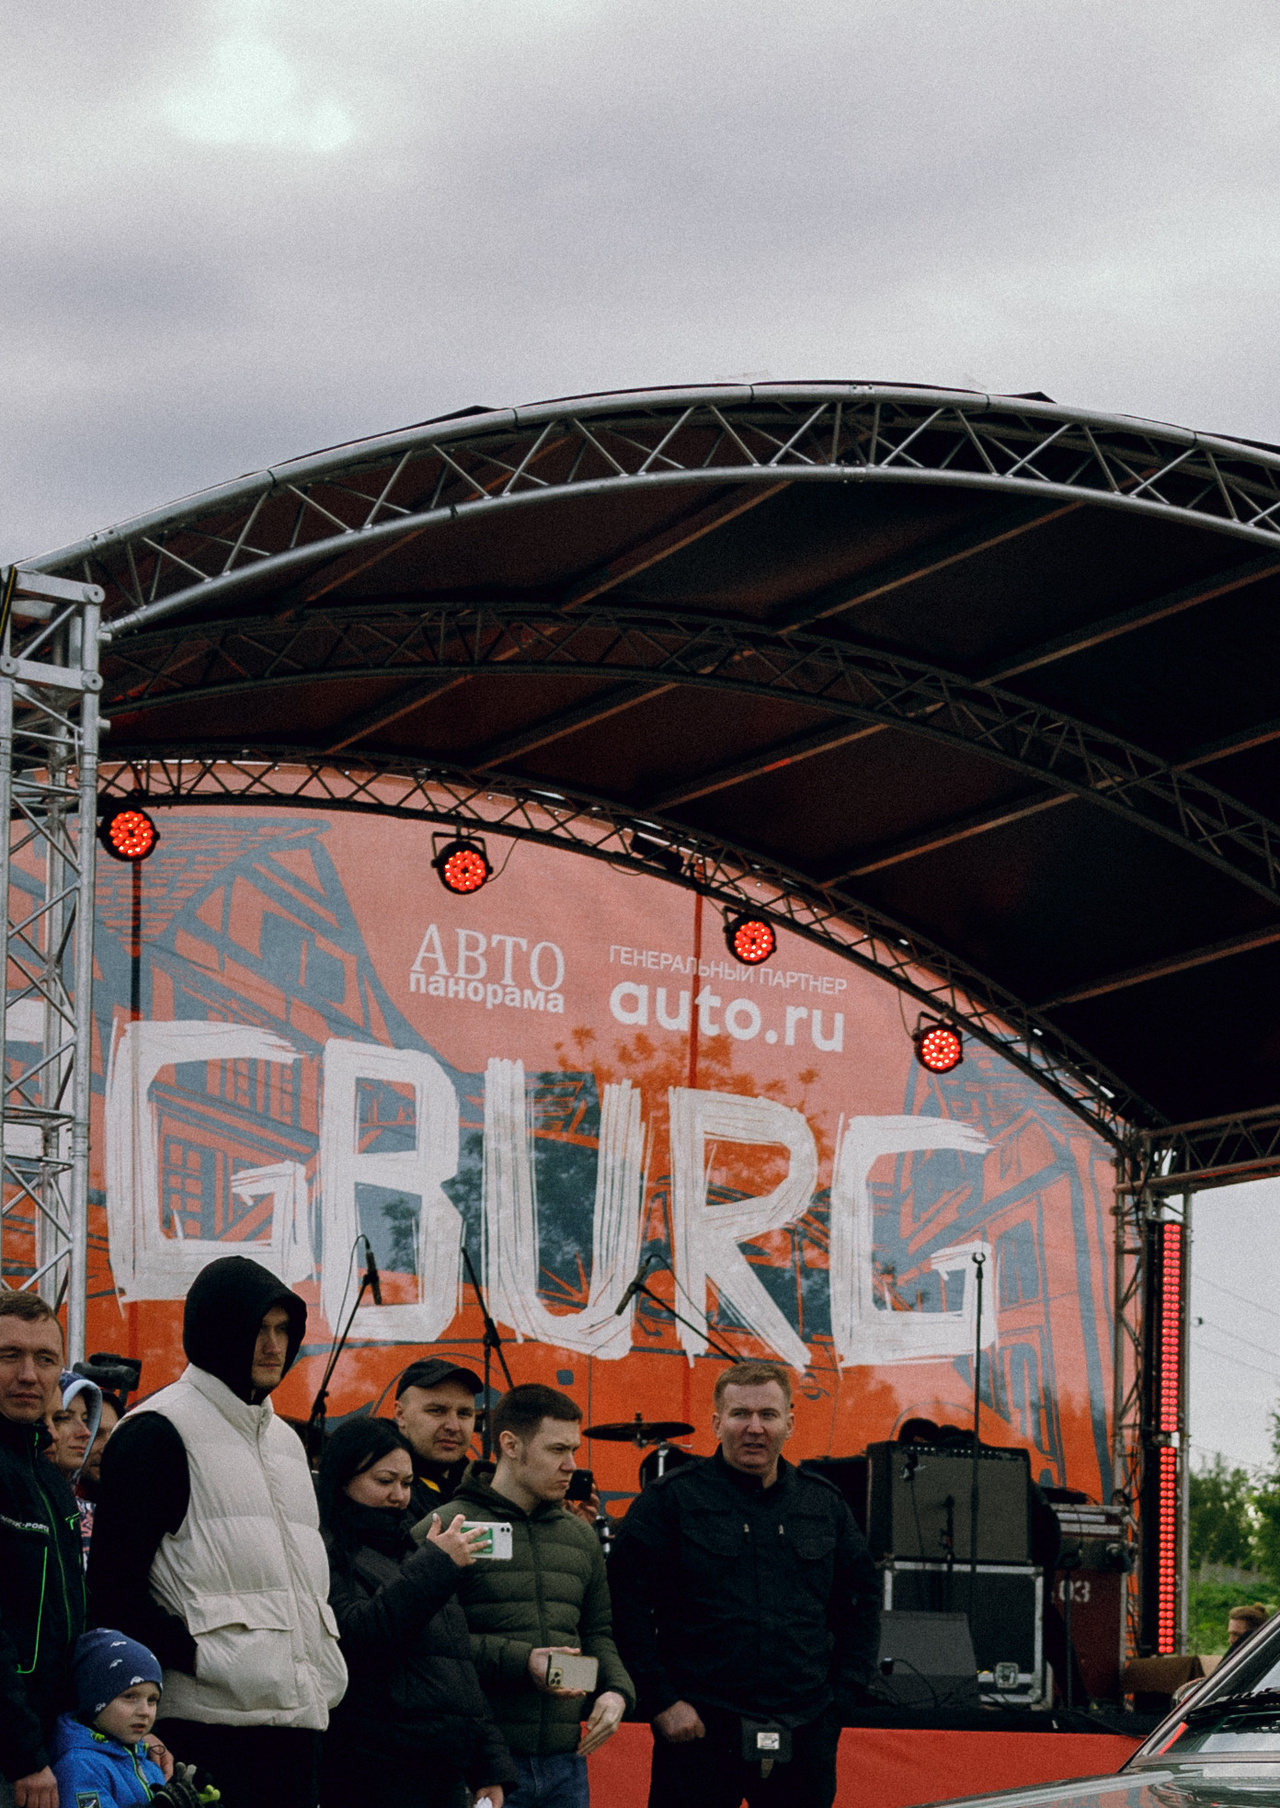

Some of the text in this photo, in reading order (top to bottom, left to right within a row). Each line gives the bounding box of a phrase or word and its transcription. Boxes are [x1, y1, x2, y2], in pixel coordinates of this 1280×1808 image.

[410, 922, 565, 992] АВТО
[609, 944, 848, 996] ГЕНЕРАЛЬНЫЙ ПАРТНЕР
[409, 970, 565, 1014] панорама
[608, 979, 846, 1053] auto.ru
